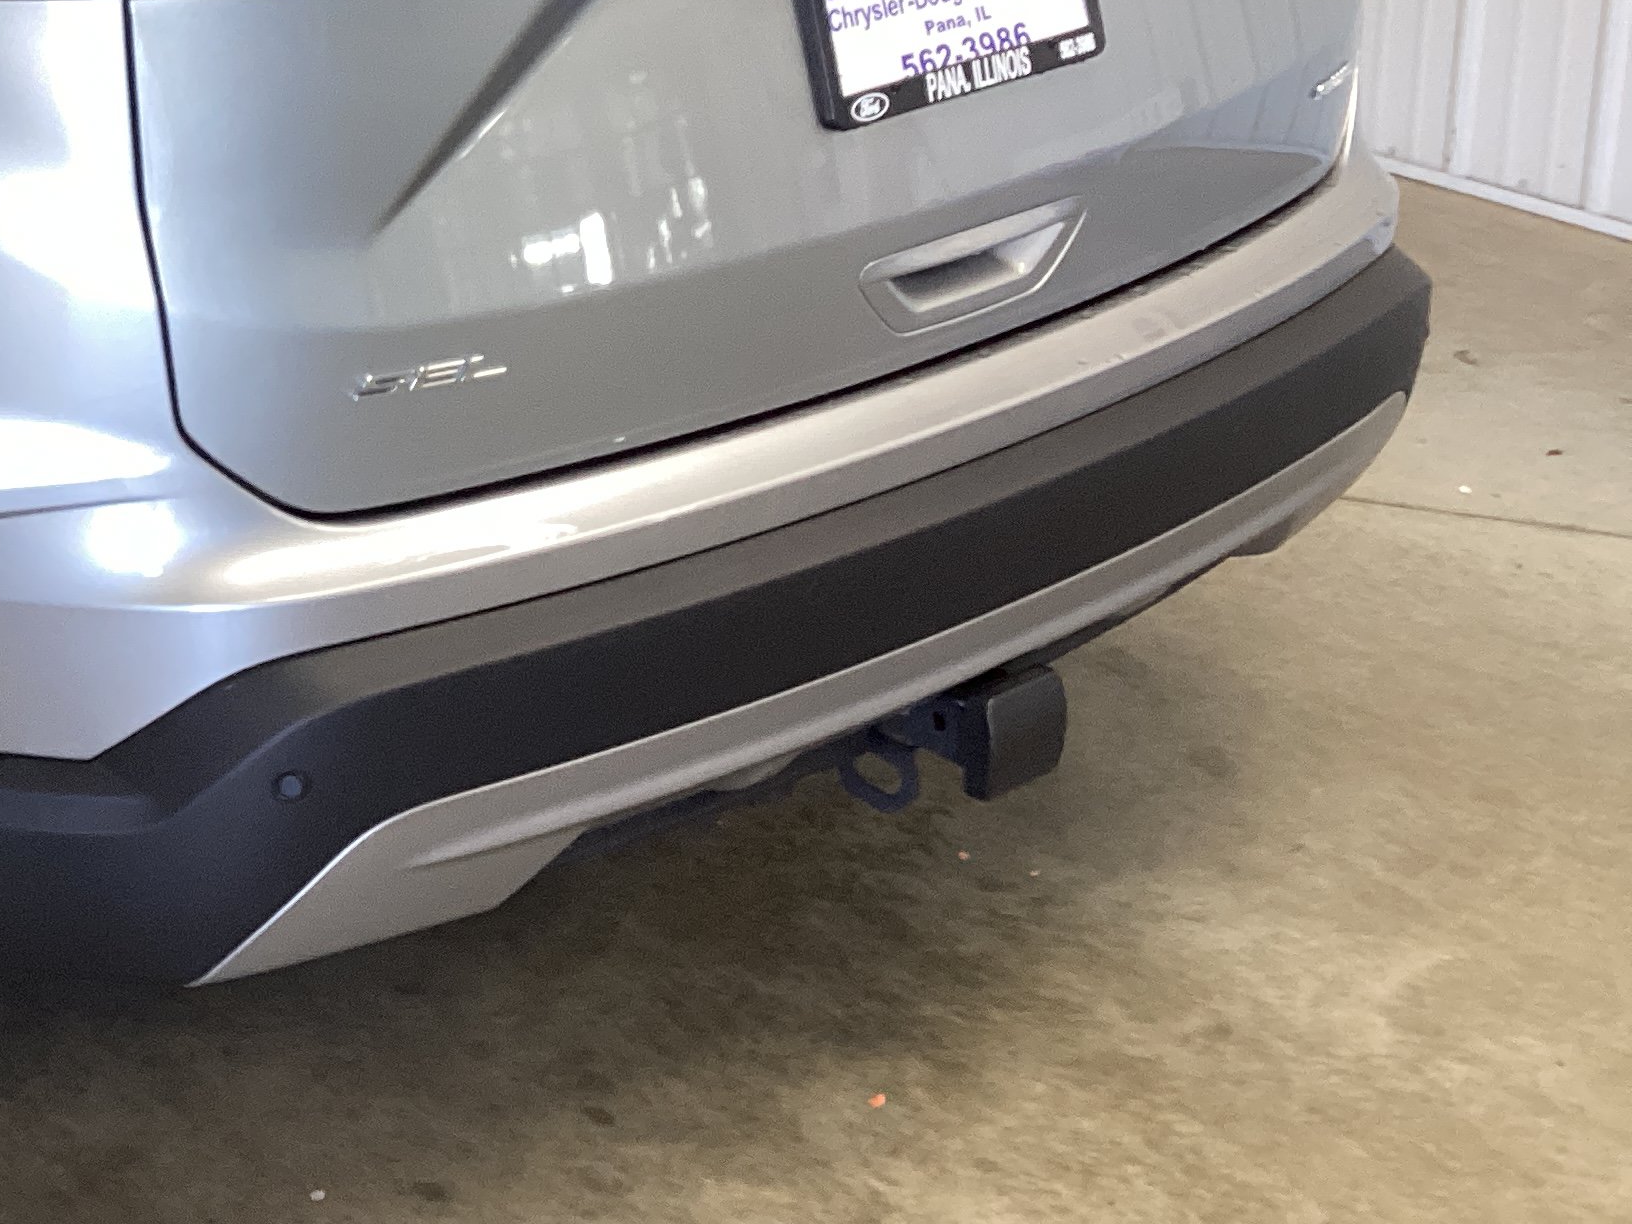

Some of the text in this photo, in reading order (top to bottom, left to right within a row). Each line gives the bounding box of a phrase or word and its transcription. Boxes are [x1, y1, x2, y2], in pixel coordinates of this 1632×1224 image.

[924, 6, 993, 36] Pana, IL
[971, 44, 1033, 91] ILLINOIS
